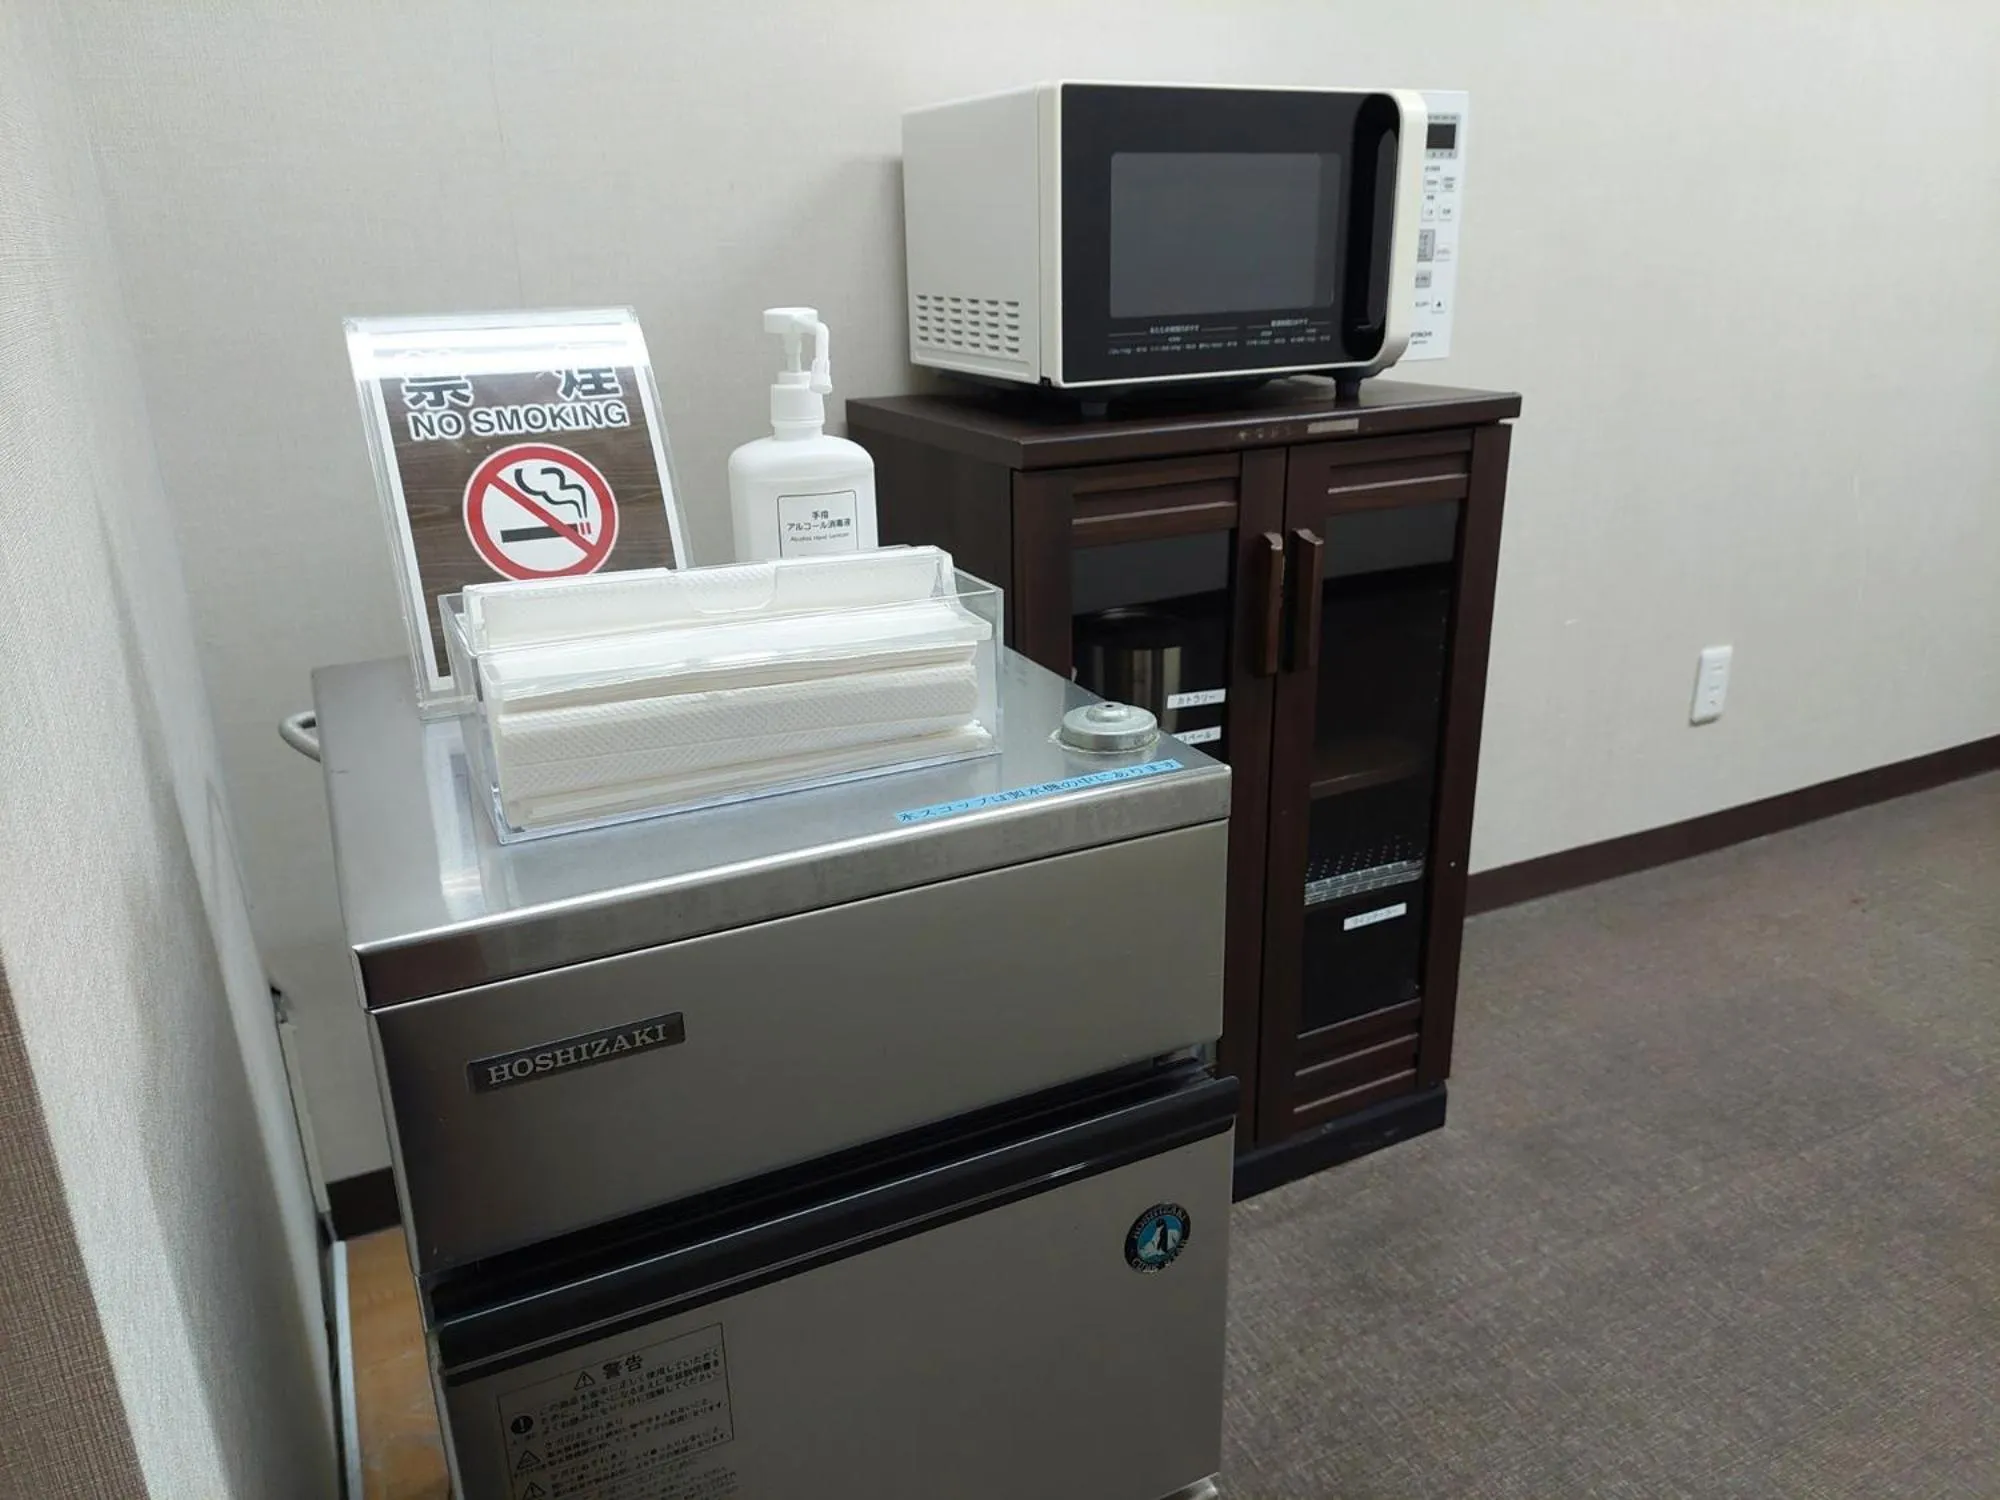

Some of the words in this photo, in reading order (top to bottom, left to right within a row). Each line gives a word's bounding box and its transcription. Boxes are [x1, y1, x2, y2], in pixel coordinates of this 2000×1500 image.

[411, 412, 462, 438] NO
[473, 402, 628, 435] SMOKING
[787, 518, 851, 531] アルコール消毒液
[488, 1023, 668, 1085] HOSHIZAKI
[602, 1354, 643, 1379] 警告
